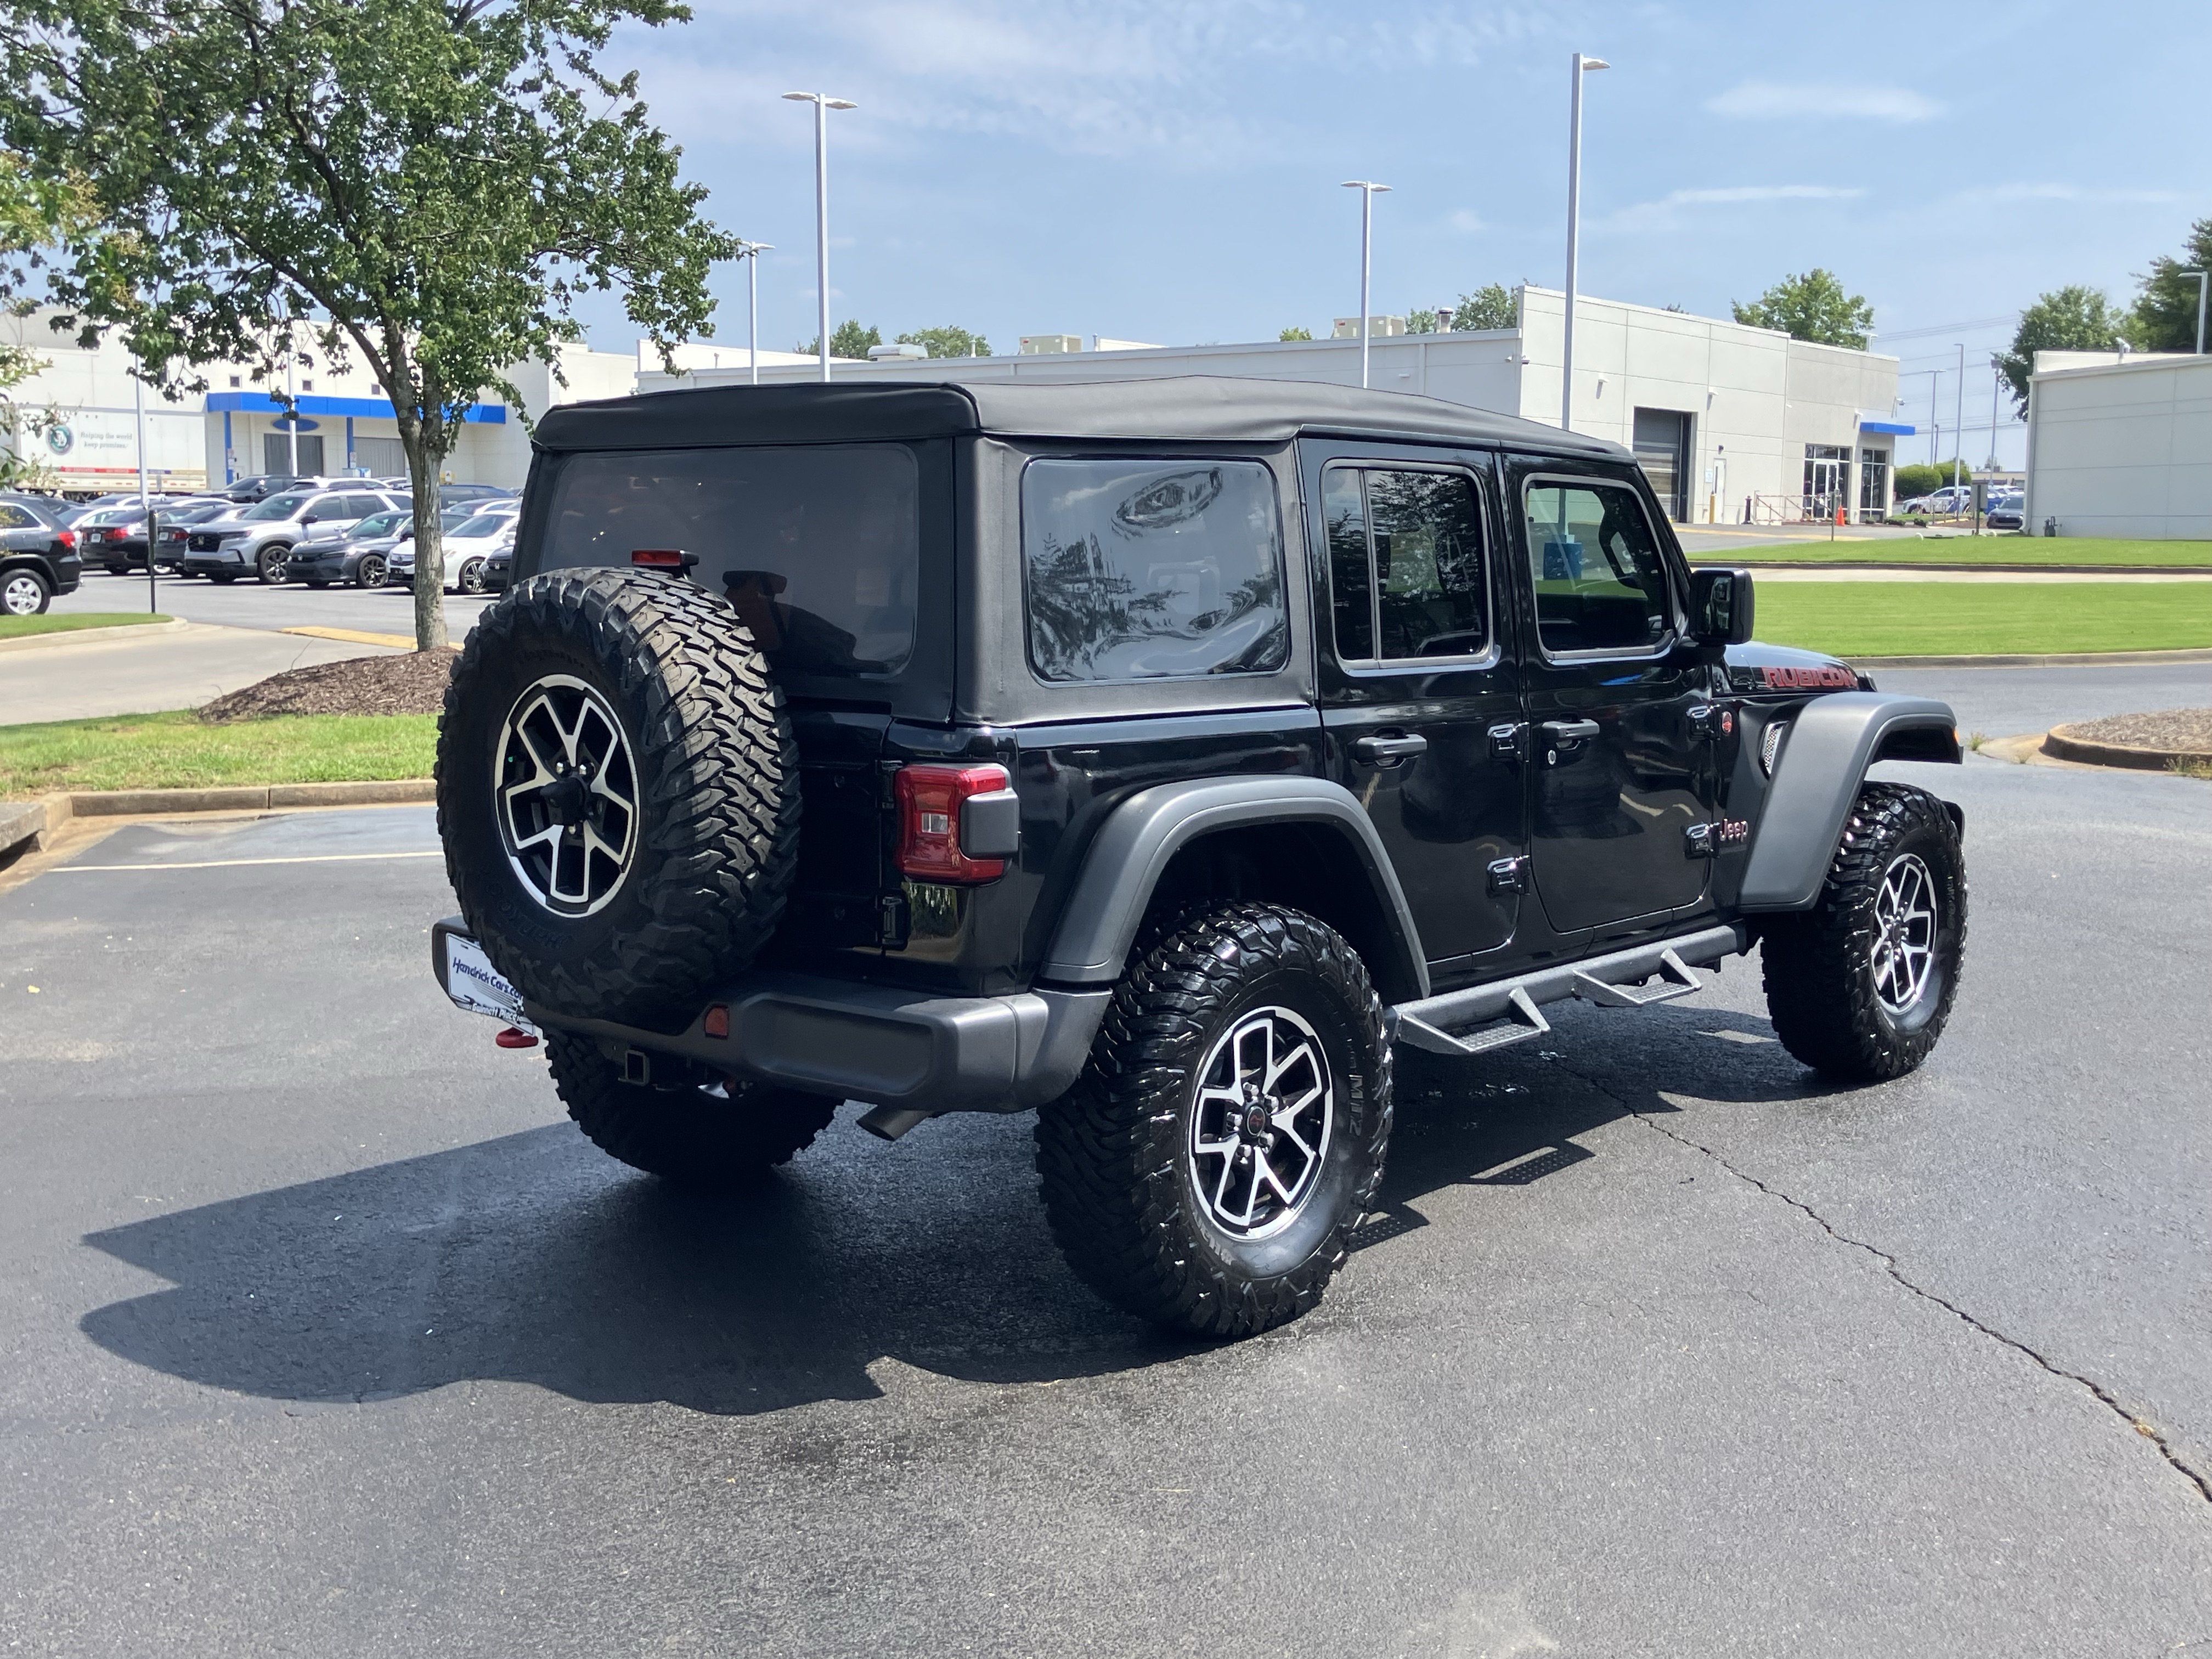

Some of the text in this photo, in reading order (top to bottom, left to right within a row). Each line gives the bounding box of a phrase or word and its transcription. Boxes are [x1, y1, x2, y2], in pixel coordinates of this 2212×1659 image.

[1761, 667, 1859, 690] RUBICON
[1719, 818, 1748, 842] Jeep
[1348, 1074, 1364, 1136] MT2
